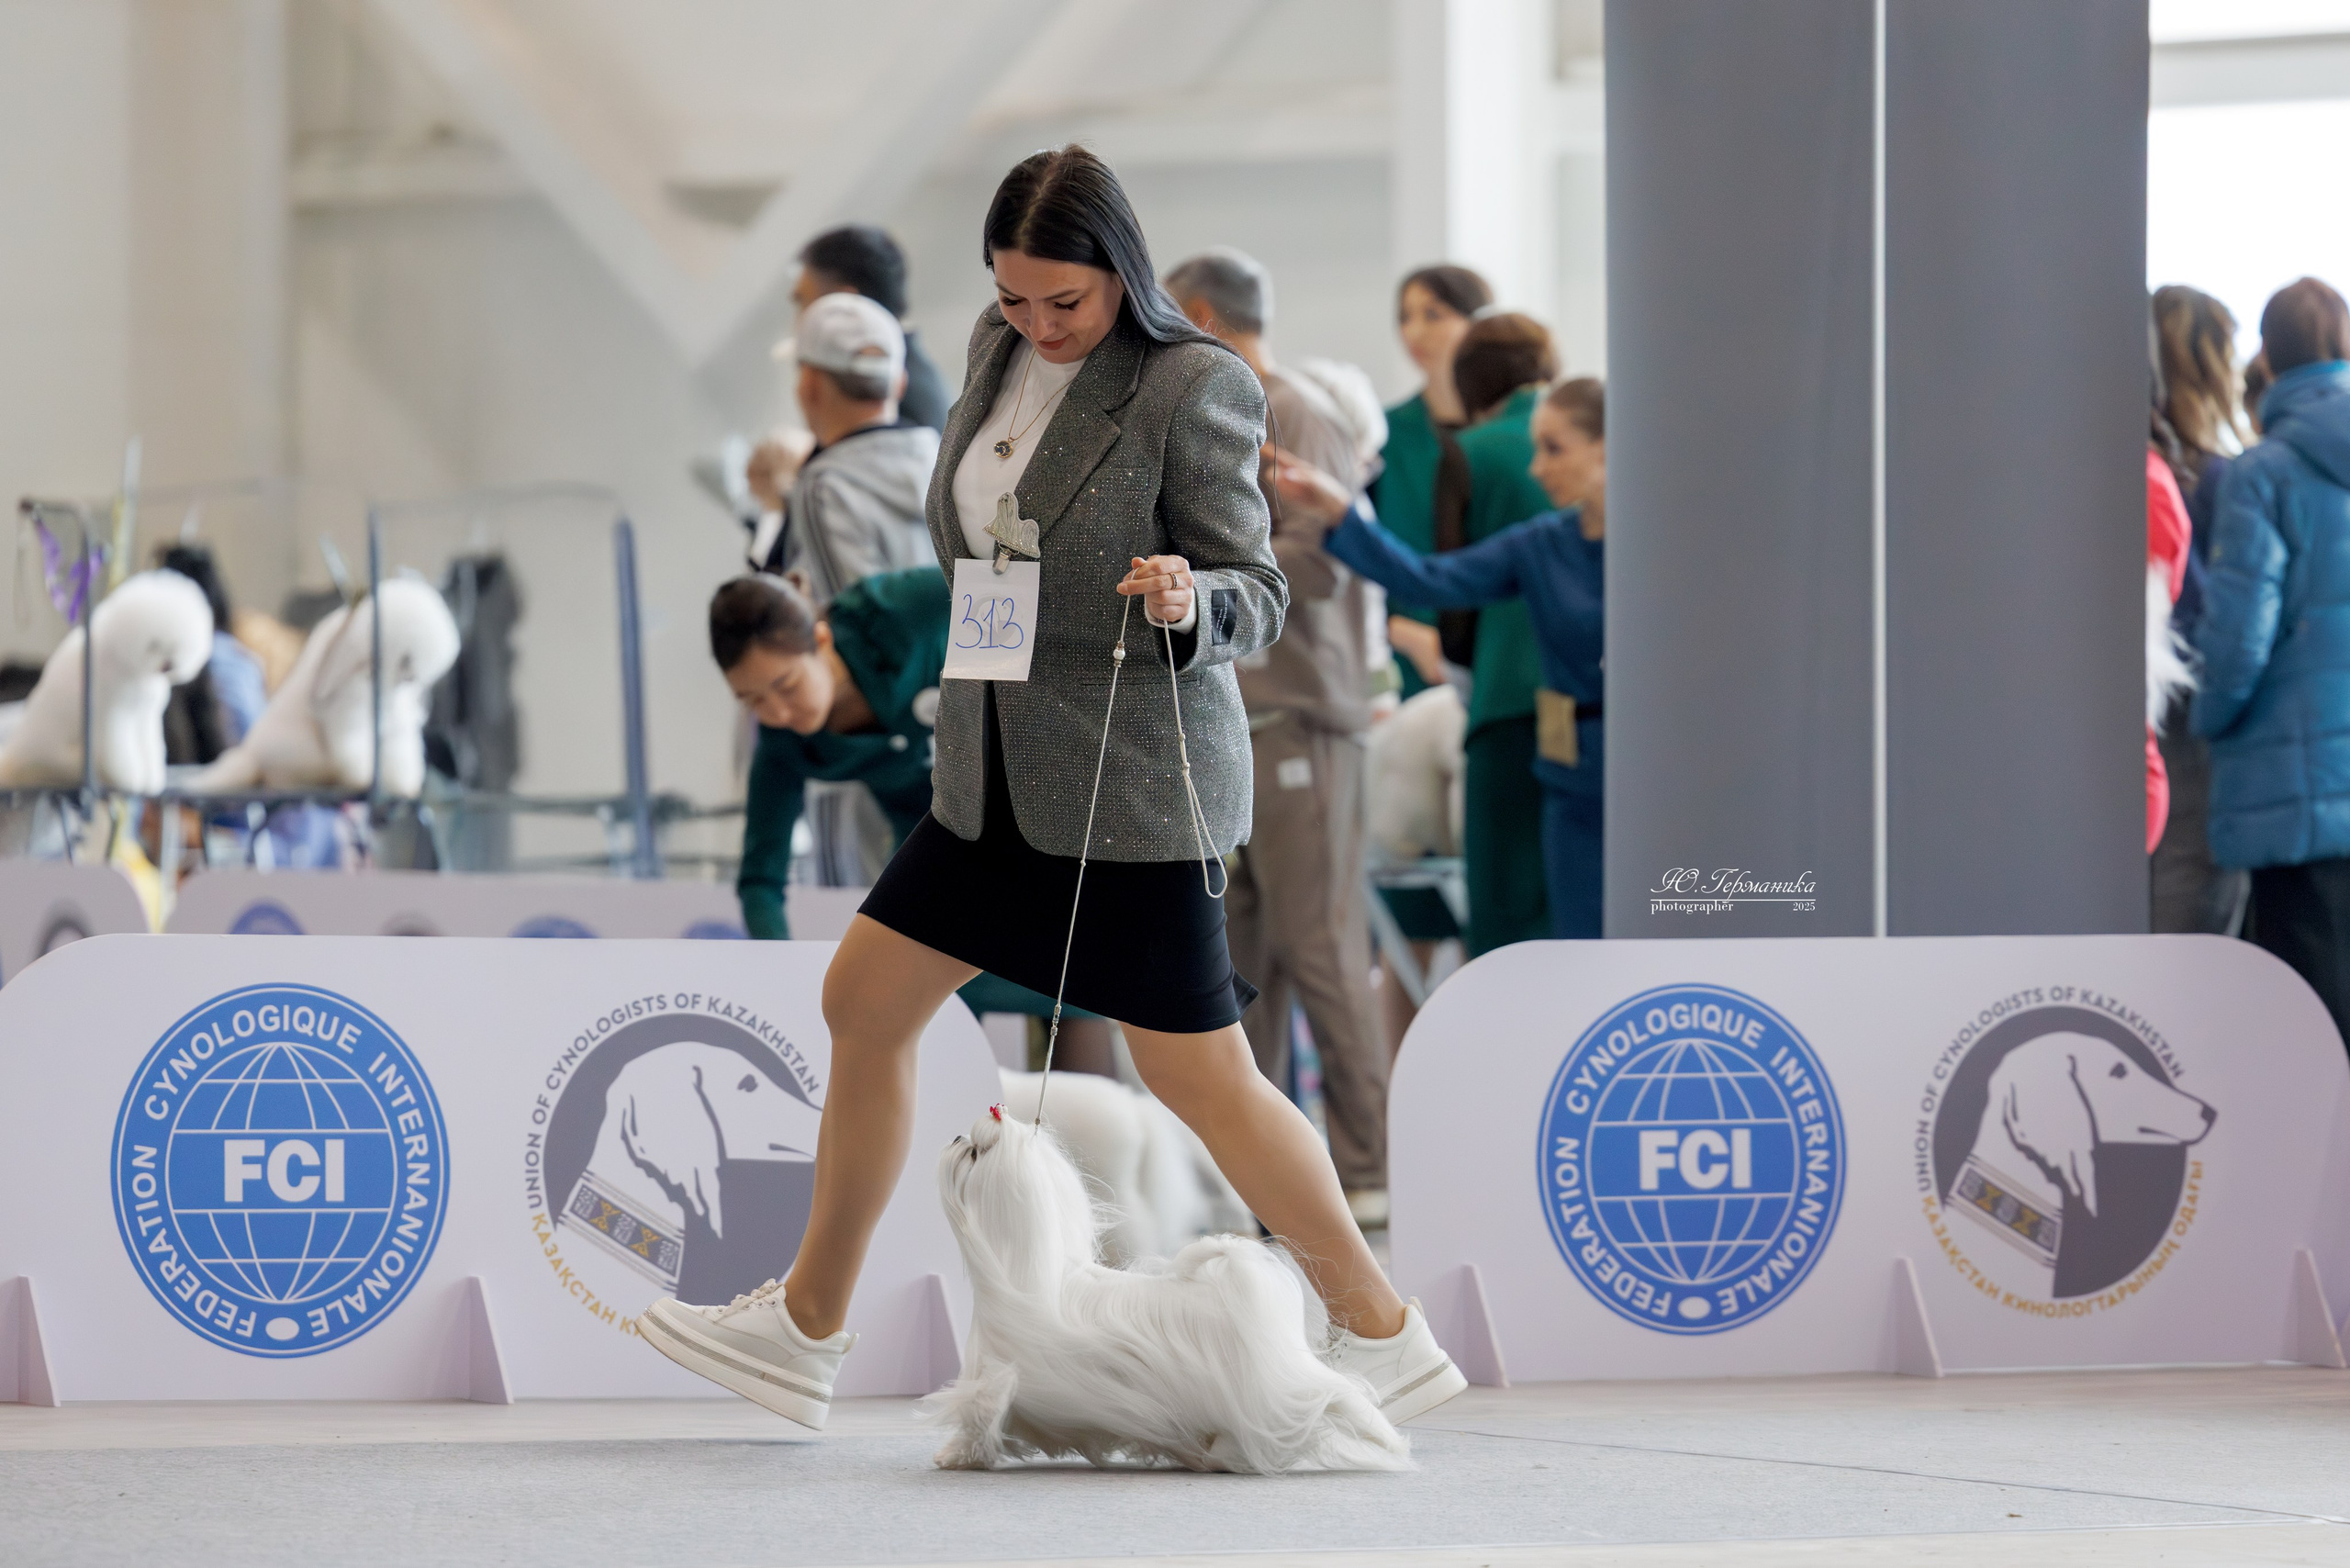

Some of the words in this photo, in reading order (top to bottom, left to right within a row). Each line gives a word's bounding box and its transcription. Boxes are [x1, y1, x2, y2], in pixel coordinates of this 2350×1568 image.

[955, 593, 1024, 649] 313
[674, 992, 702, 1009] OF
[1933, 987, 2044, 1081] CYNOLOGISTS
[2049, 986, 2076, 1002] OF
[2079, 990, 2185, 1080] KAZAKHSTAN
[144, 1003, 363, 1121] CYNOLOGIQUE
[545, 993, 667, 1091] CYNOLOGISTS
[708, 996, 820, 1093] KAZAKHSTAN
[1566, 1002, 1765, 1114] CYNOLOGIQUE
[532, 1093, 551, 1126] OF
[1920, 1084, 1938, 1113] OF
[223, 1138, 345, 1203] FCI
[307, 1051, 431, 1338] INTERNANIONALE
[525, 1133, 543, 1209] UNION
[1639, 1128, 1751, 1191] FCI
[1717, 1047, 1830, 1316] INTERNANIONALE
[1914, 1120, 1931, 1193] UNION
[131, 1144, 258, 1338] FEDERATION
[1555, 1137, 1673, 1316] FEDERATION
